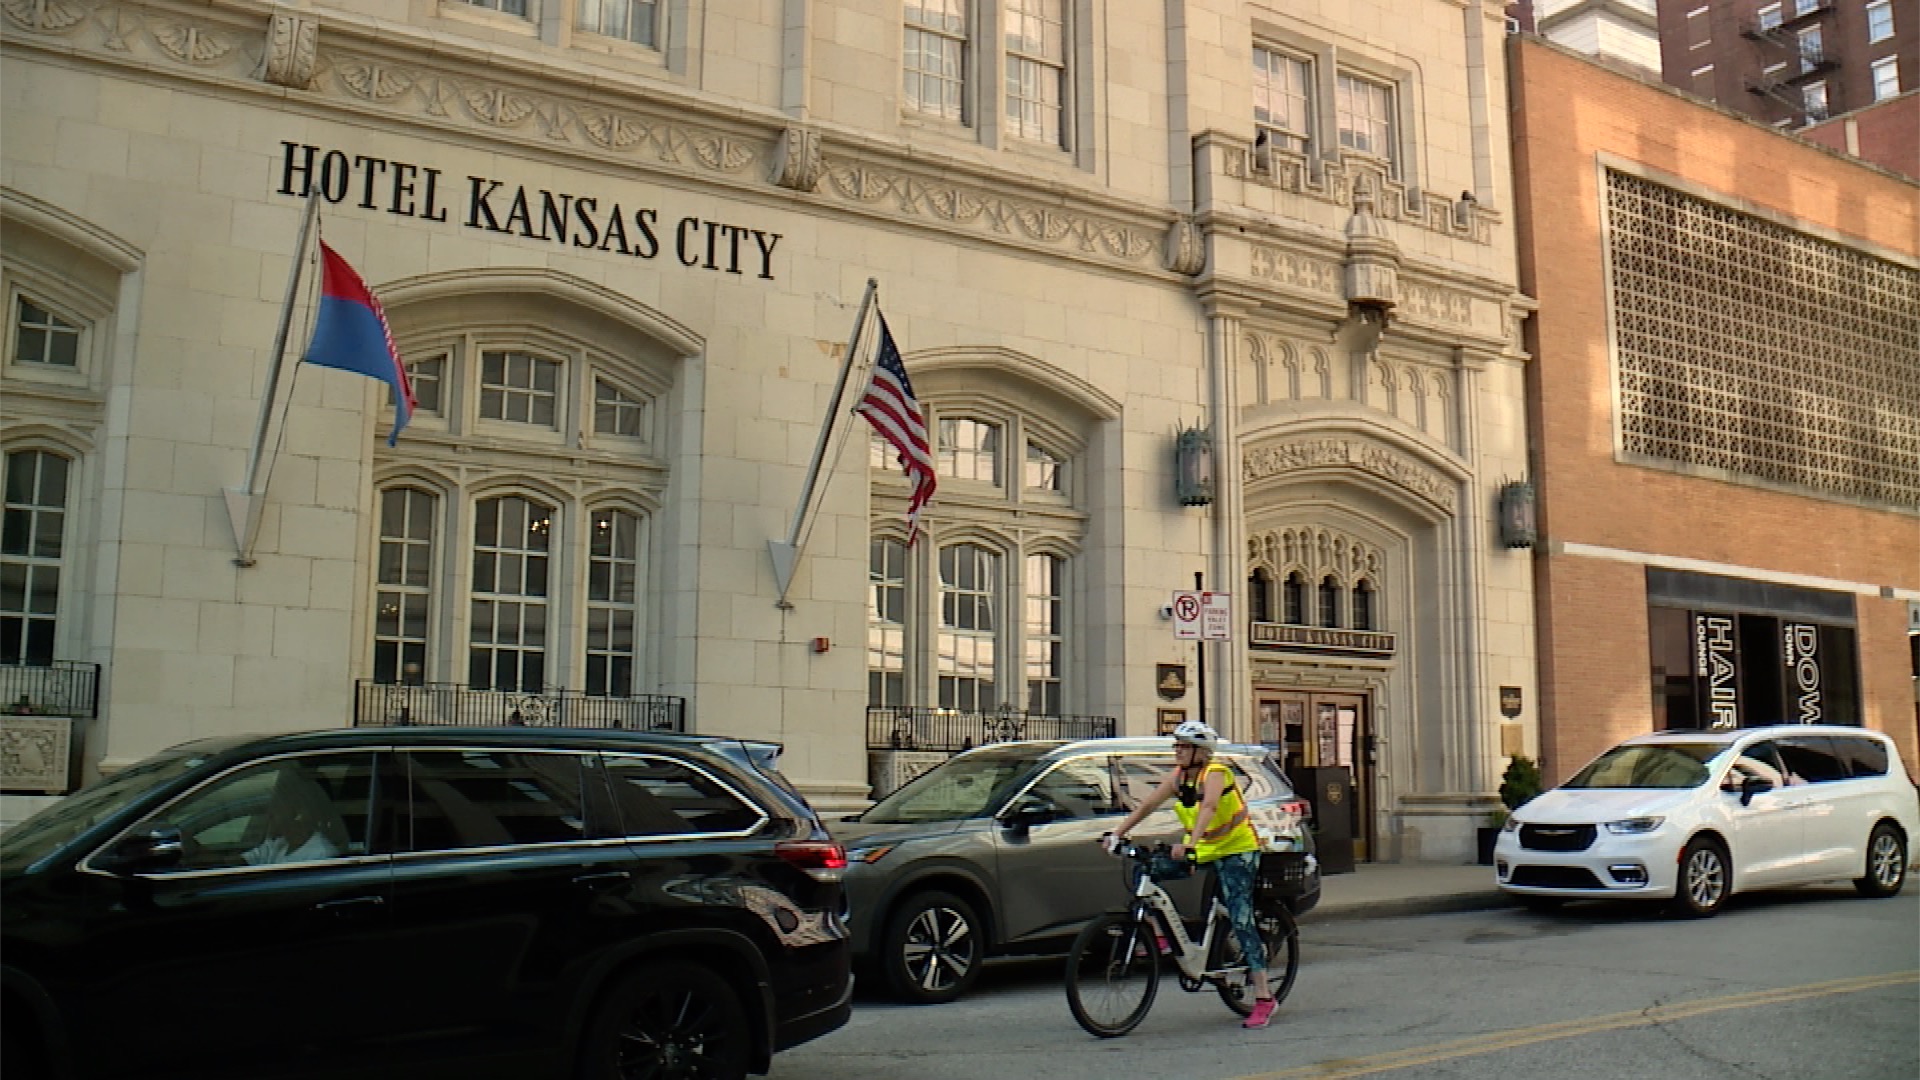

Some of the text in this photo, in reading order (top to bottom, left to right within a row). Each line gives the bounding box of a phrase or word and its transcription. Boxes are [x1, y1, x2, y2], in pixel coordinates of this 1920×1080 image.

[277, 141, 783, 280] HOTEL KANSAS CITY
[1257, 625, 1391, 650] HOTEL KANSAS CITY
[1696, 615, 1708, 677] LOUNGE
[1707, 617, 1737, 729] HAIR
[1784, 624, 1795, 667] TOWN
[1794, 625, 1821, 726] DOW
